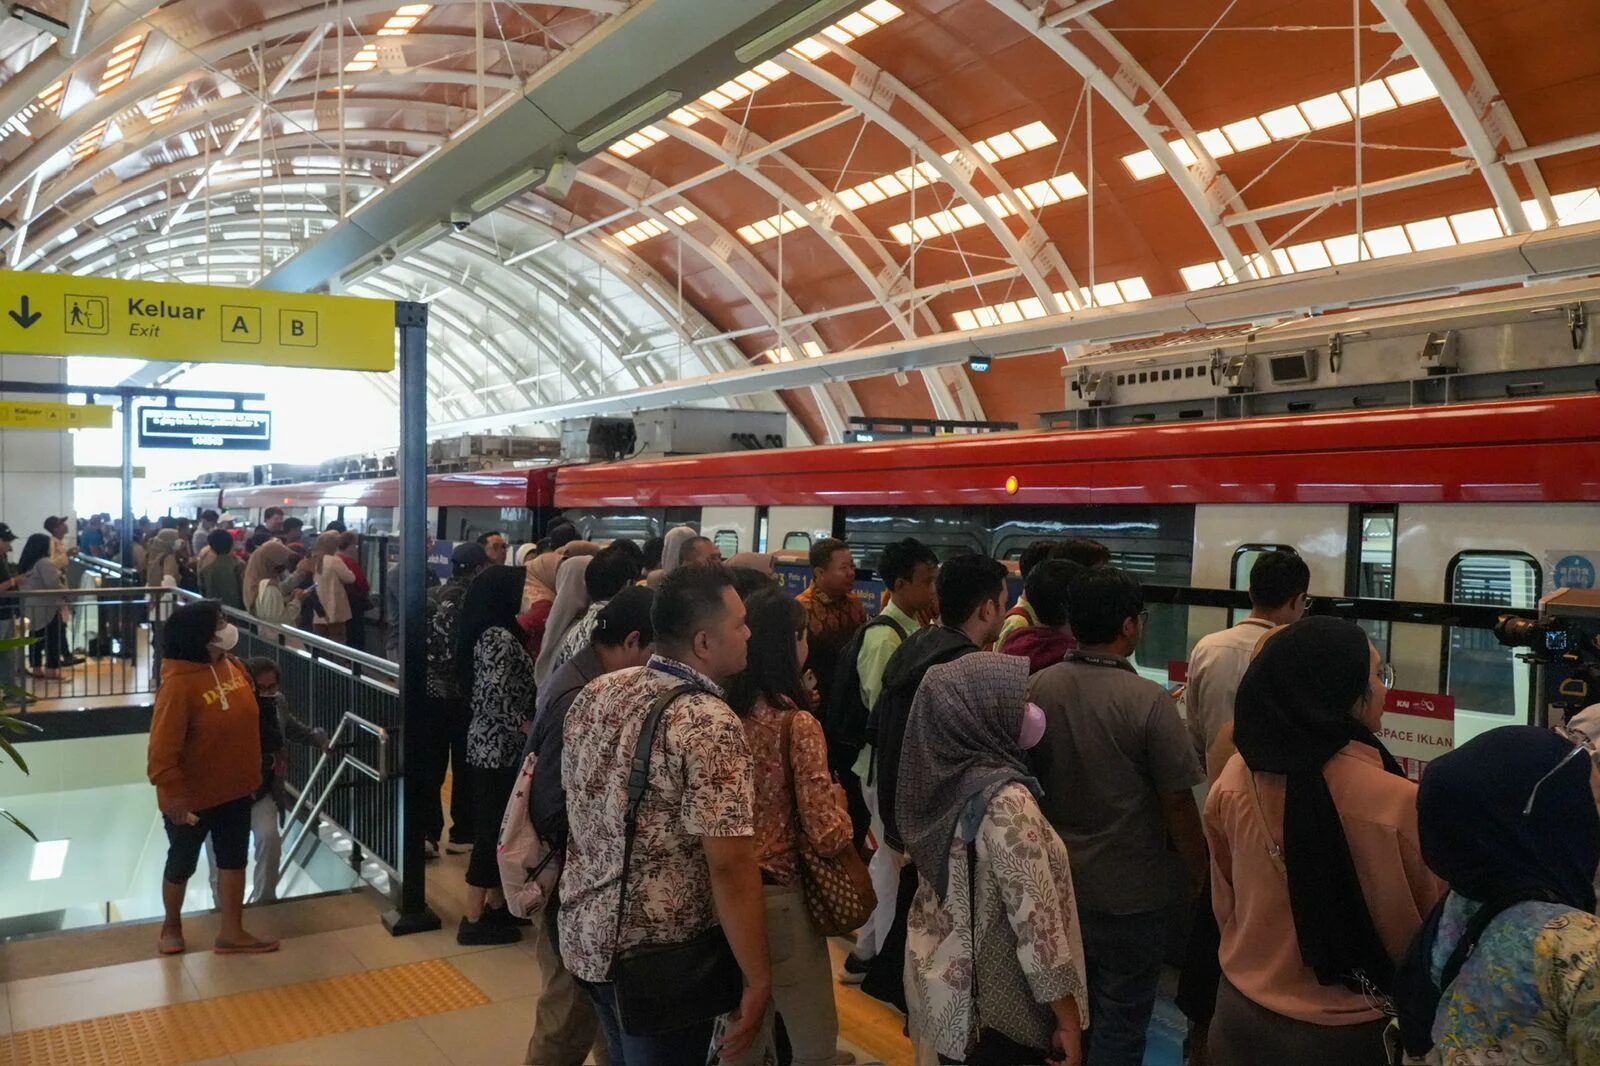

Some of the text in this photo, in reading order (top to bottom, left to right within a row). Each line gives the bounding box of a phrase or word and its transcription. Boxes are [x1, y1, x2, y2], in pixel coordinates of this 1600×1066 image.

[128, 298, 205, 320] Keluar
[129, 323, 160, 338] Exit
[231, 316, 304, 336] A B
[1377, 728, 1453, 747] SPACE IKLAN
